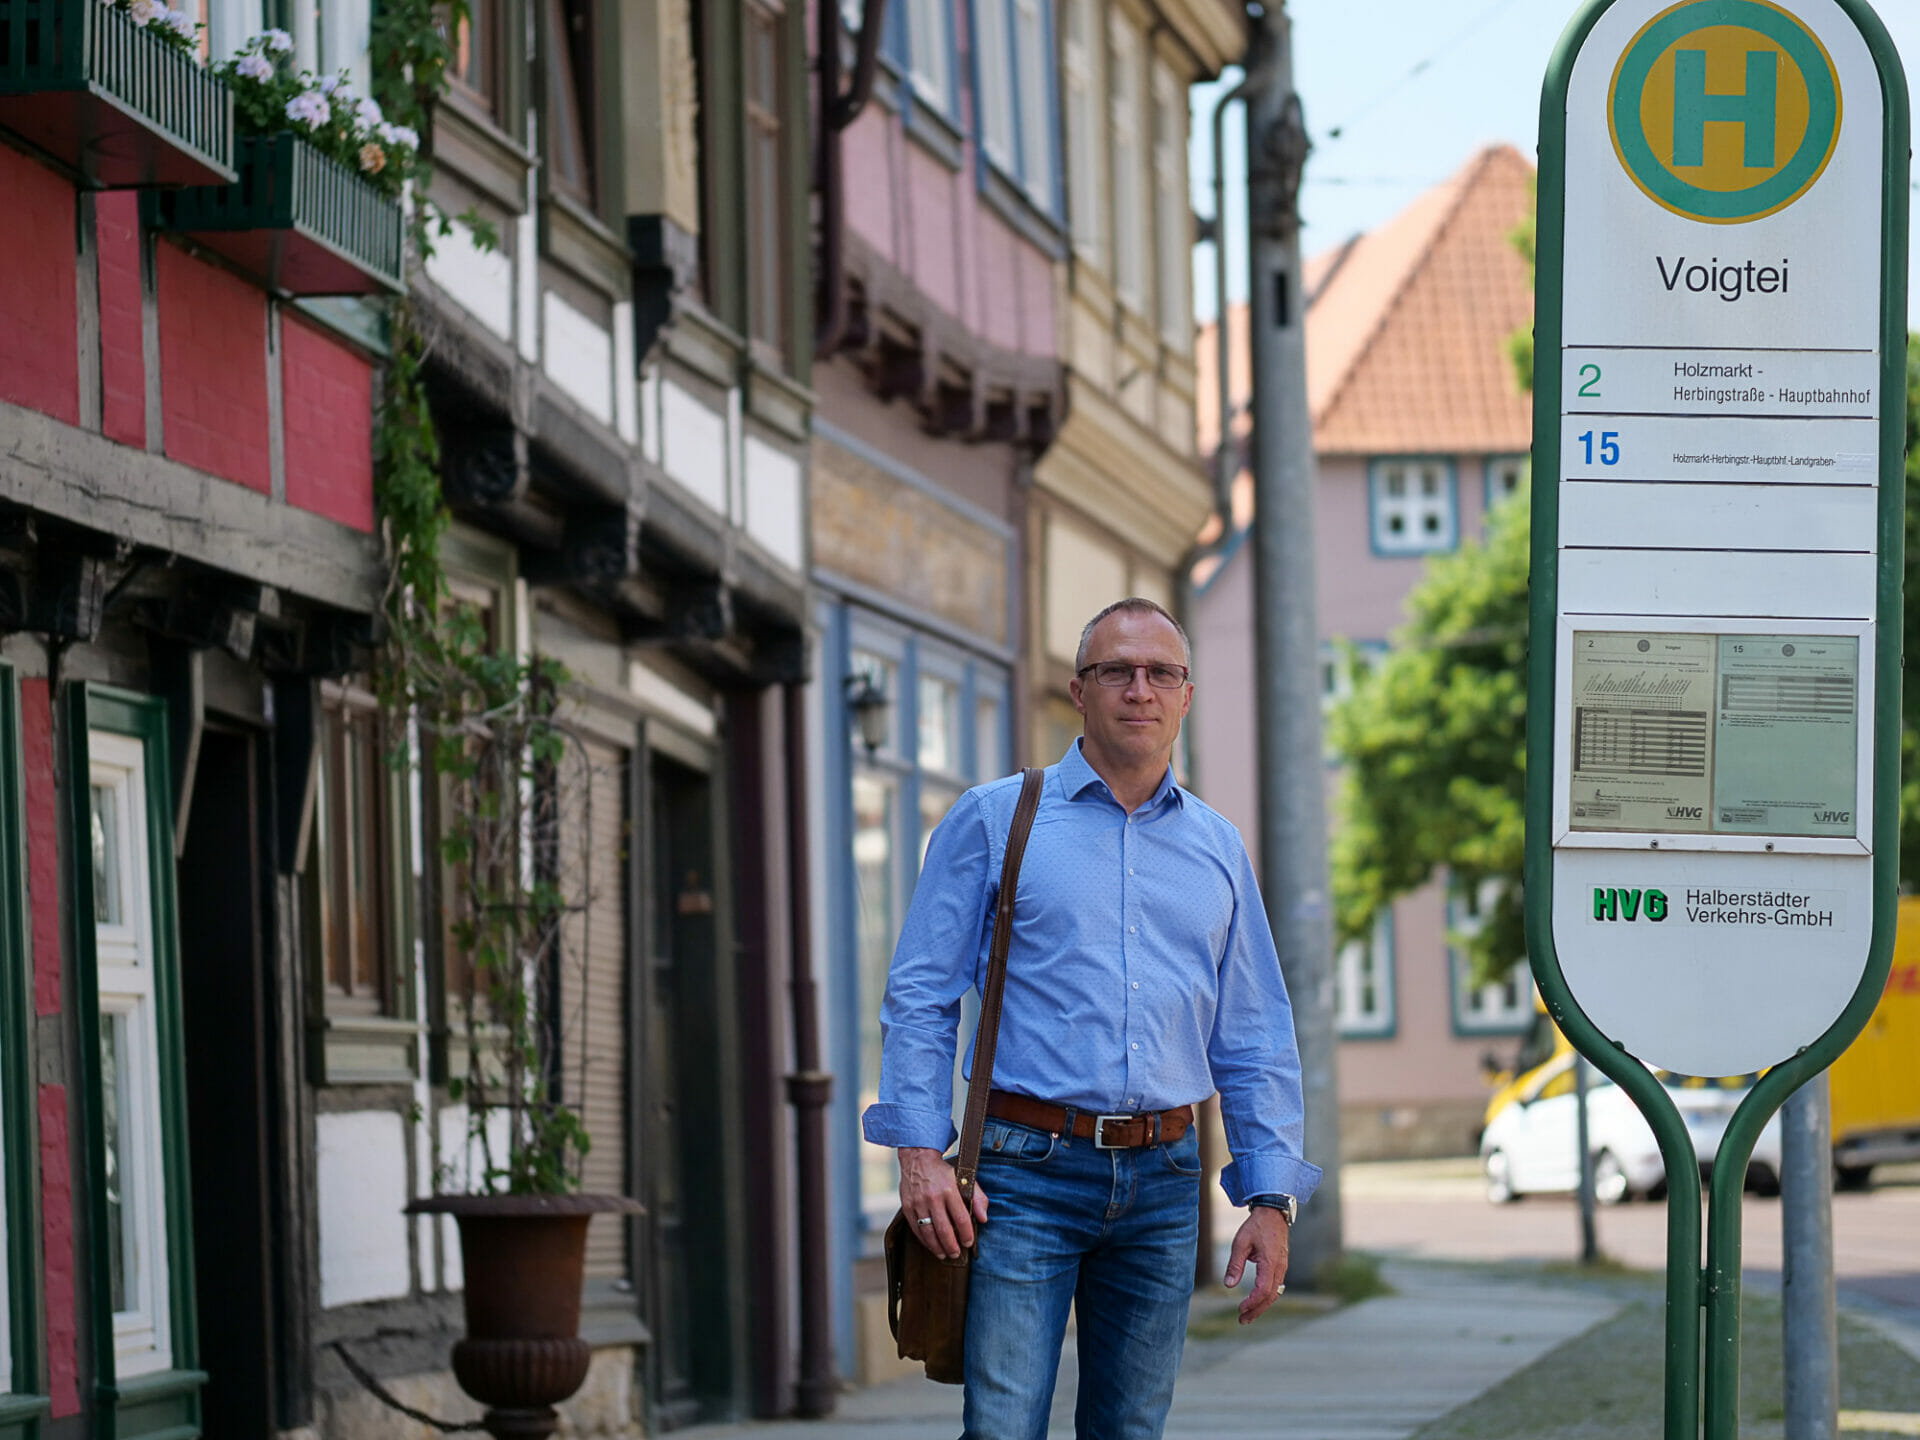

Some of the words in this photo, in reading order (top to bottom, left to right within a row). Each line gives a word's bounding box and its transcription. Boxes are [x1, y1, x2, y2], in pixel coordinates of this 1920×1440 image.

[1672, 49, 1778, 168] H
[1656, 256, 1789, 302] Voigtei
[1674, 361, 1753, 378] Holzmarkt
[1578, 363, 1602, 397] 2
[1673, 386, 1765, 405] Herbingstraße
[1779, 387, 1871, 406] Hauptbahnhof
[1578, 430, 1620, 466] 15
[1588, 640, 1594, 648] 2
[1733, 645, 1744, 653] 15
[1675, 806, 1703, 818] HVG
[1823, 811, 1850, 823] HVG
[1594, 888, 1668, 922] HVG
[1686, 889, 1811, 908] Halberstädter
[1686, 906, 1833, 927] Verkehrs-GmbH
